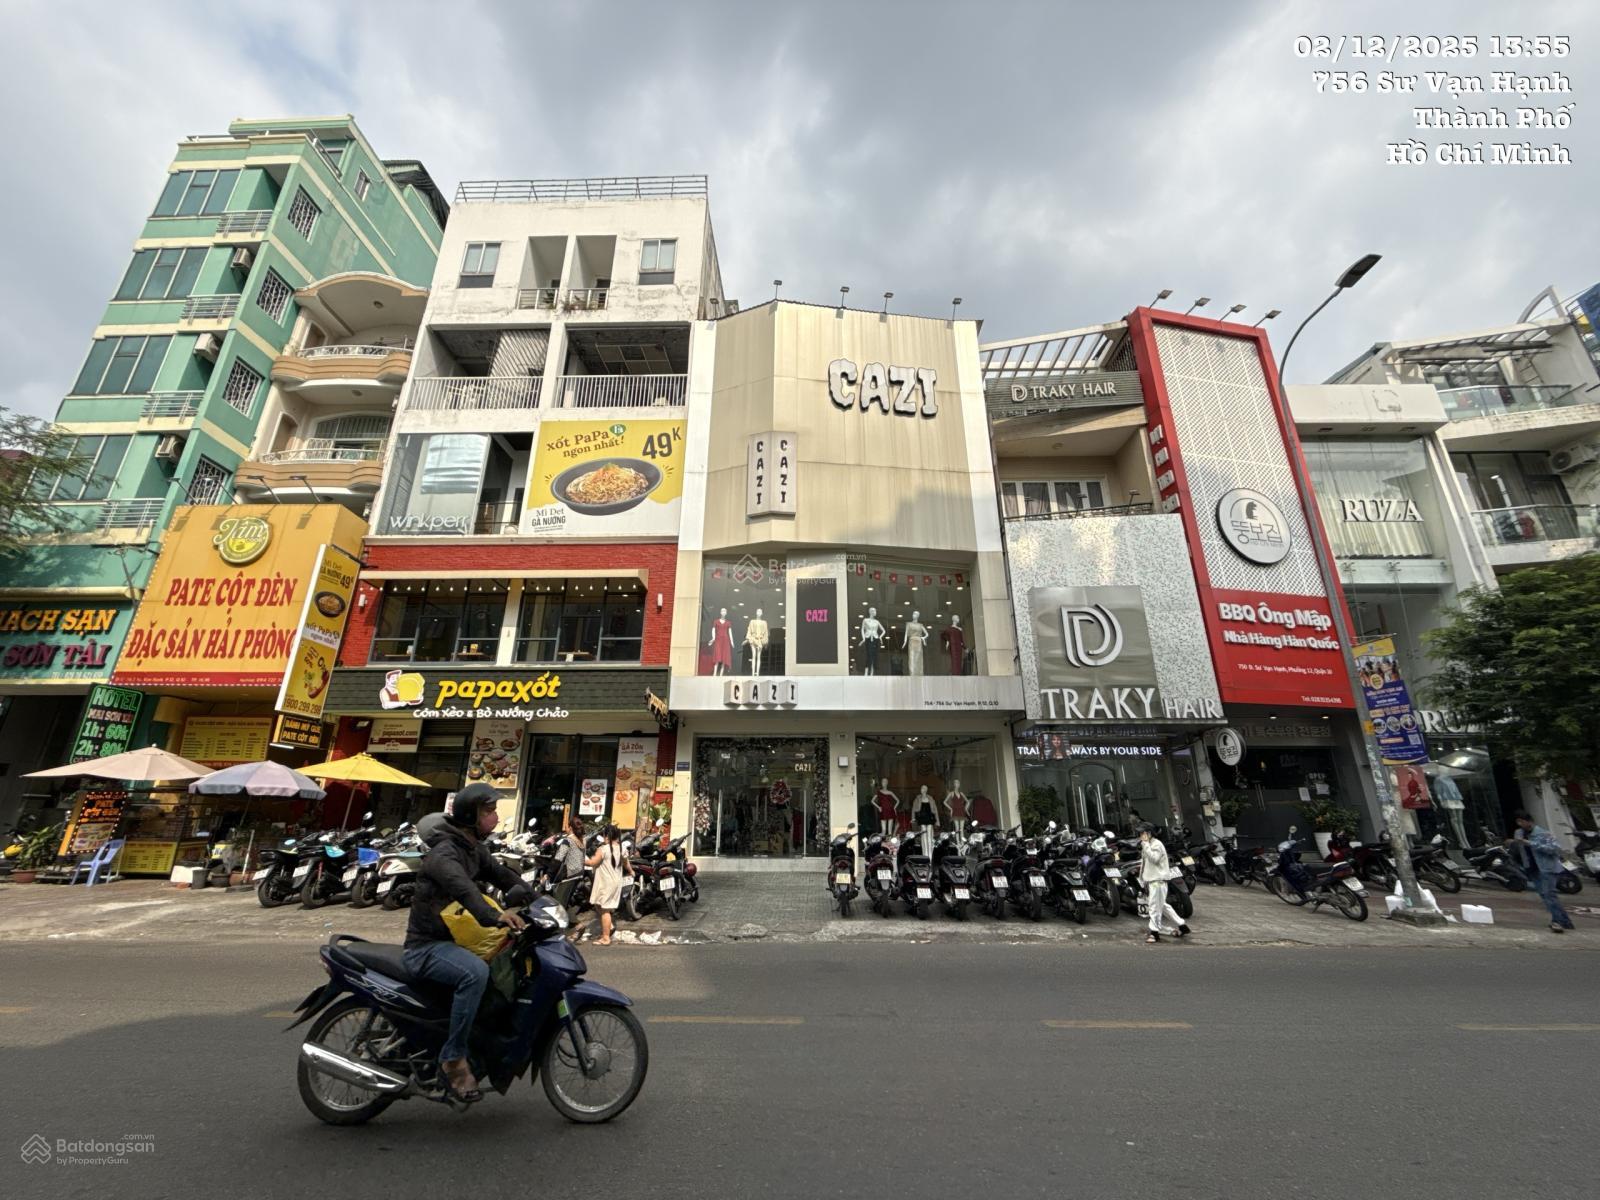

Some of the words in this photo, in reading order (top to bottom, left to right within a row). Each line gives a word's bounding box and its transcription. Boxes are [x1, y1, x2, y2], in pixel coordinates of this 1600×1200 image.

[828, 358, 939, 420] CAZI
[1032, 384, 1076, 399] TRAKY
[1082, 381, 1117, 396] HAIR
[574, 430, 609, 446] PaPa
[562, 446, 591, 459] ngon
[755, 440, 764, 505] CAZI
[780, 439, 789, 504] CAZI
[1340, 499, 1424, 522] RUZA
[165, 577, 216, 607] PATE
[215, 570, 256, 615] CỘT
[254, 571, 298, 607] ĐÈN
[61, 609, 116, 636] SẠN
[806, 609, 828, 622] CAZI
[1219, 604, 1255, 622] BBQ
[1258, 602, 1296, 624] Ông
[1297, 607, 1332, 631] Mập
[125, 620, 166, 667] ĐẶC
[163, 617, 206, 659] SẢN
[202, 617, 242, 659] HẢI
[1224, 631, 1249, 643] Nhà
[1250, 632, 1280, 648] Hàng
[1308, 635, 1340, 650] Quốc
[92, 688, 137, 711] HOTEL
[435, 671, 561, 708] papaxốt
[734, 684, 795, 701] CAZI
[442, 706, 464, 718] Xèo
[476, 706, 491, 718] Bò
[495, 707, 534, 721] Nướng
[536, 707, 569, 718] Chảo
[1041, 687, 1156, 719] TRAKY
[1163, 698, 1220, 719] HAIR
[1100, 746, 1111, 755] BY
[1112, 746, 1139, 755] YOUR
[1141, 747, 1162, 756] SIDE
[795, 763, 811, 771] CAZI
